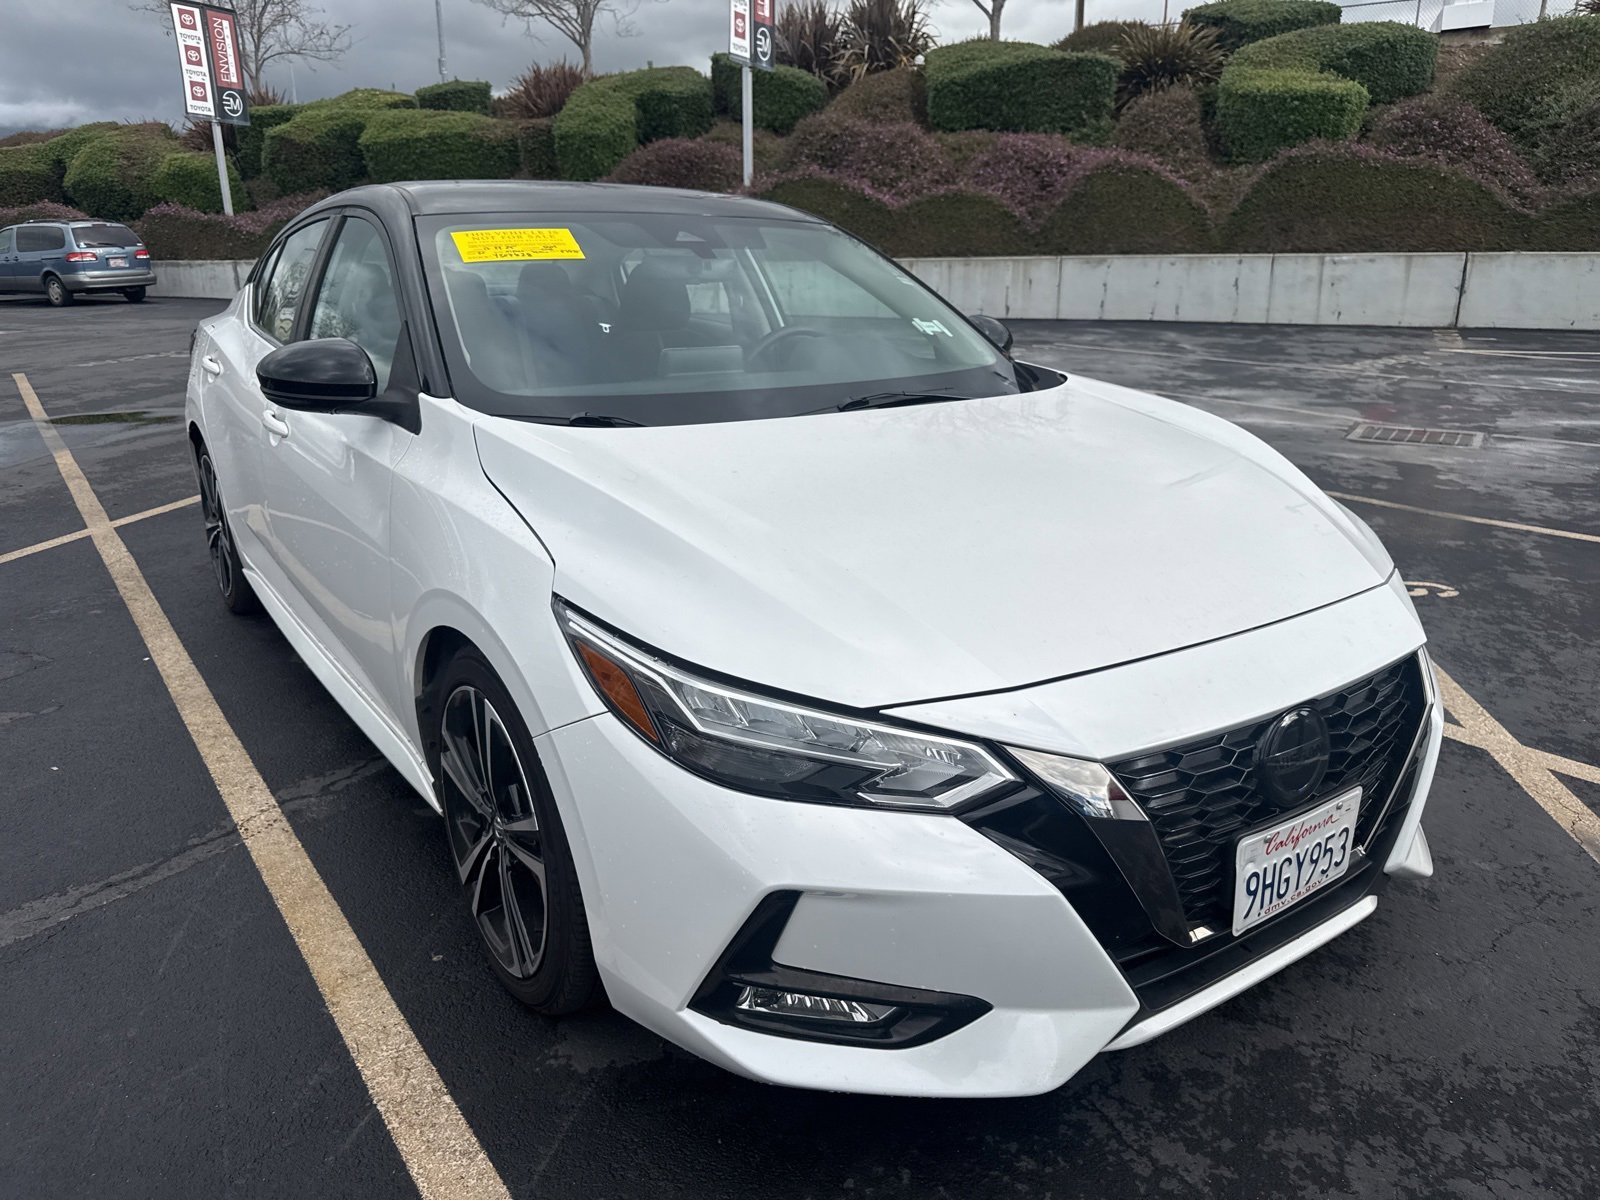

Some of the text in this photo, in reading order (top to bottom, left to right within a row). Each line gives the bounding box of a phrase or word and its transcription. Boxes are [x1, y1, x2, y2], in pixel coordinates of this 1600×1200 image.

[179, 33, 202, 41] TOYOTA
[212, 17, 231, 82] ENVISION
[185, 69, 207, 77] TOYOTA
[1265, 812, 1340, 856] California
[1243, 826, 1350, 920] 9HGY953
[1264, 878, 1324, 916] dmv.ca.gov
